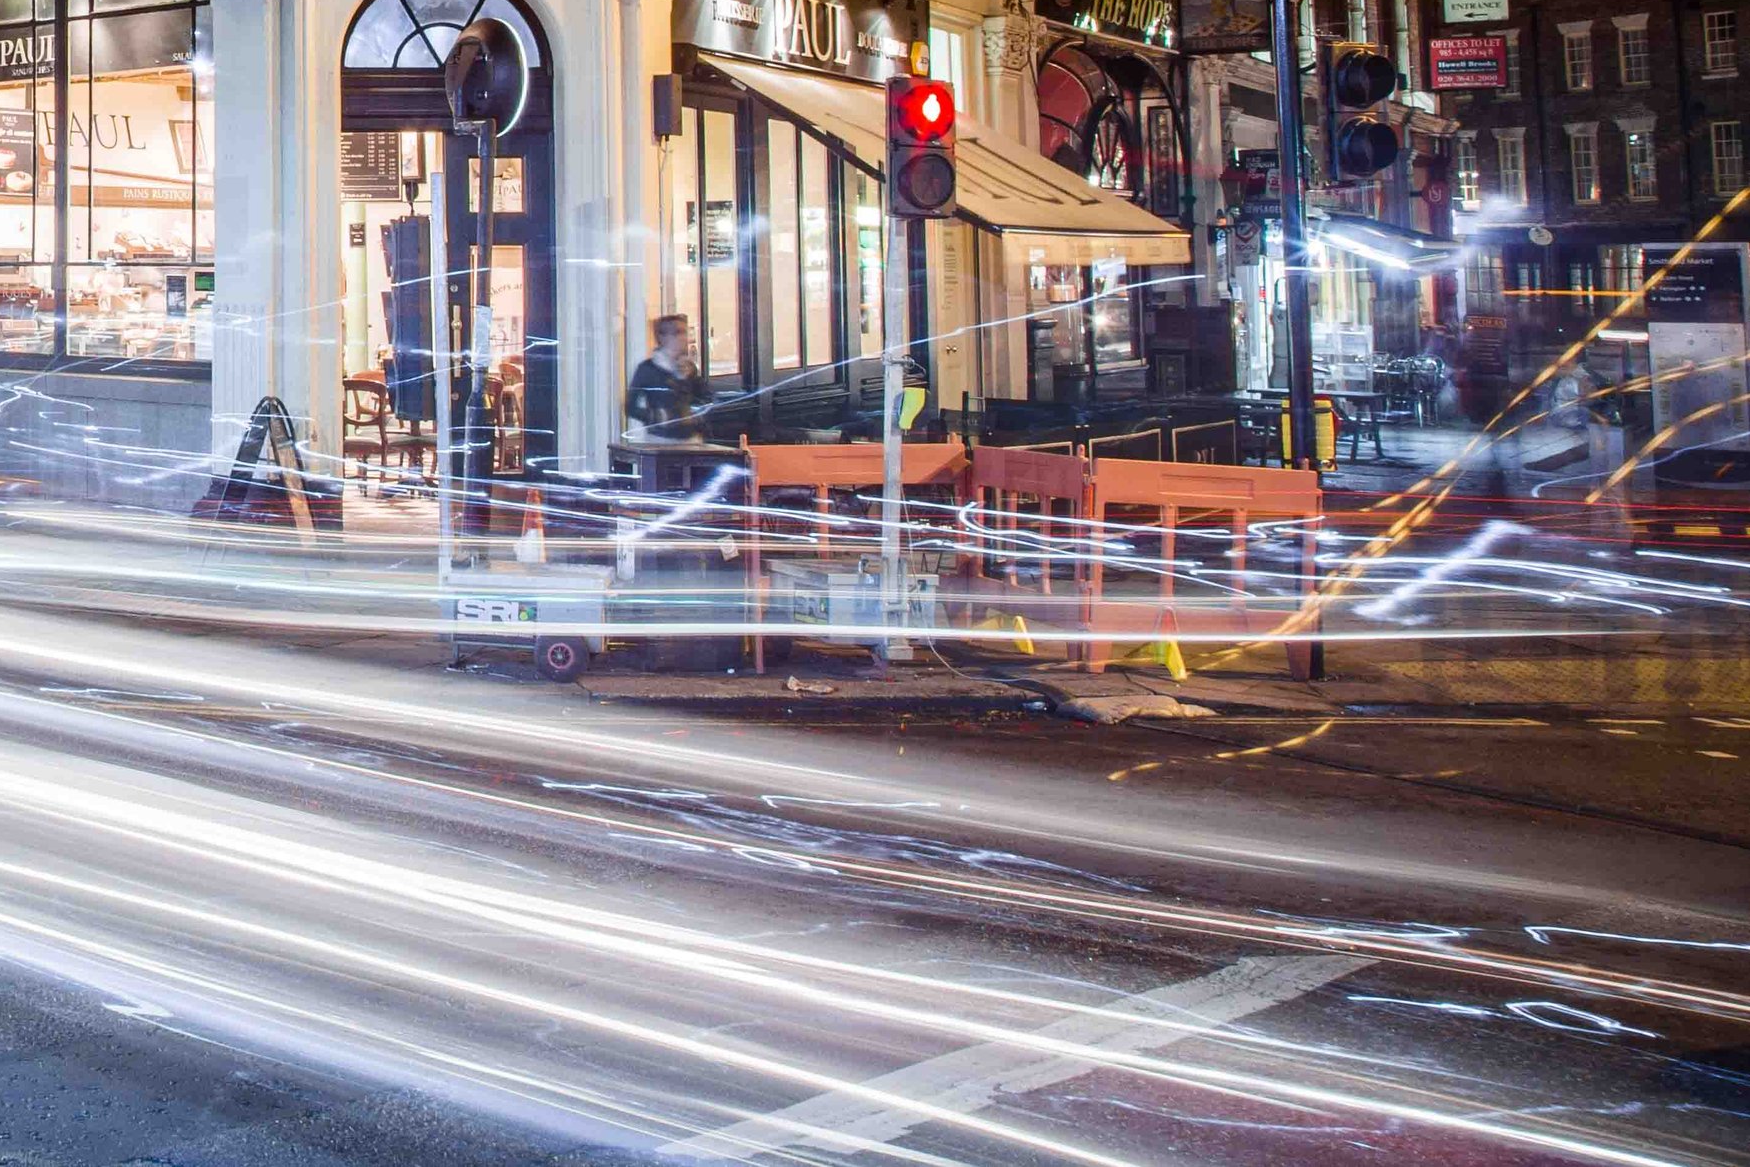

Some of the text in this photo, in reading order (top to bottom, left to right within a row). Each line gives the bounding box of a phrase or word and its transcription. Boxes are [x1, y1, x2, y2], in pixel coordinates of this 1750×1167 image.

[1451, 2, 1502, 11] ENTRANCE
[1431, 38, 1501, 48] OFFICES TO LET
[0, 35, 55, 66] PAUL
